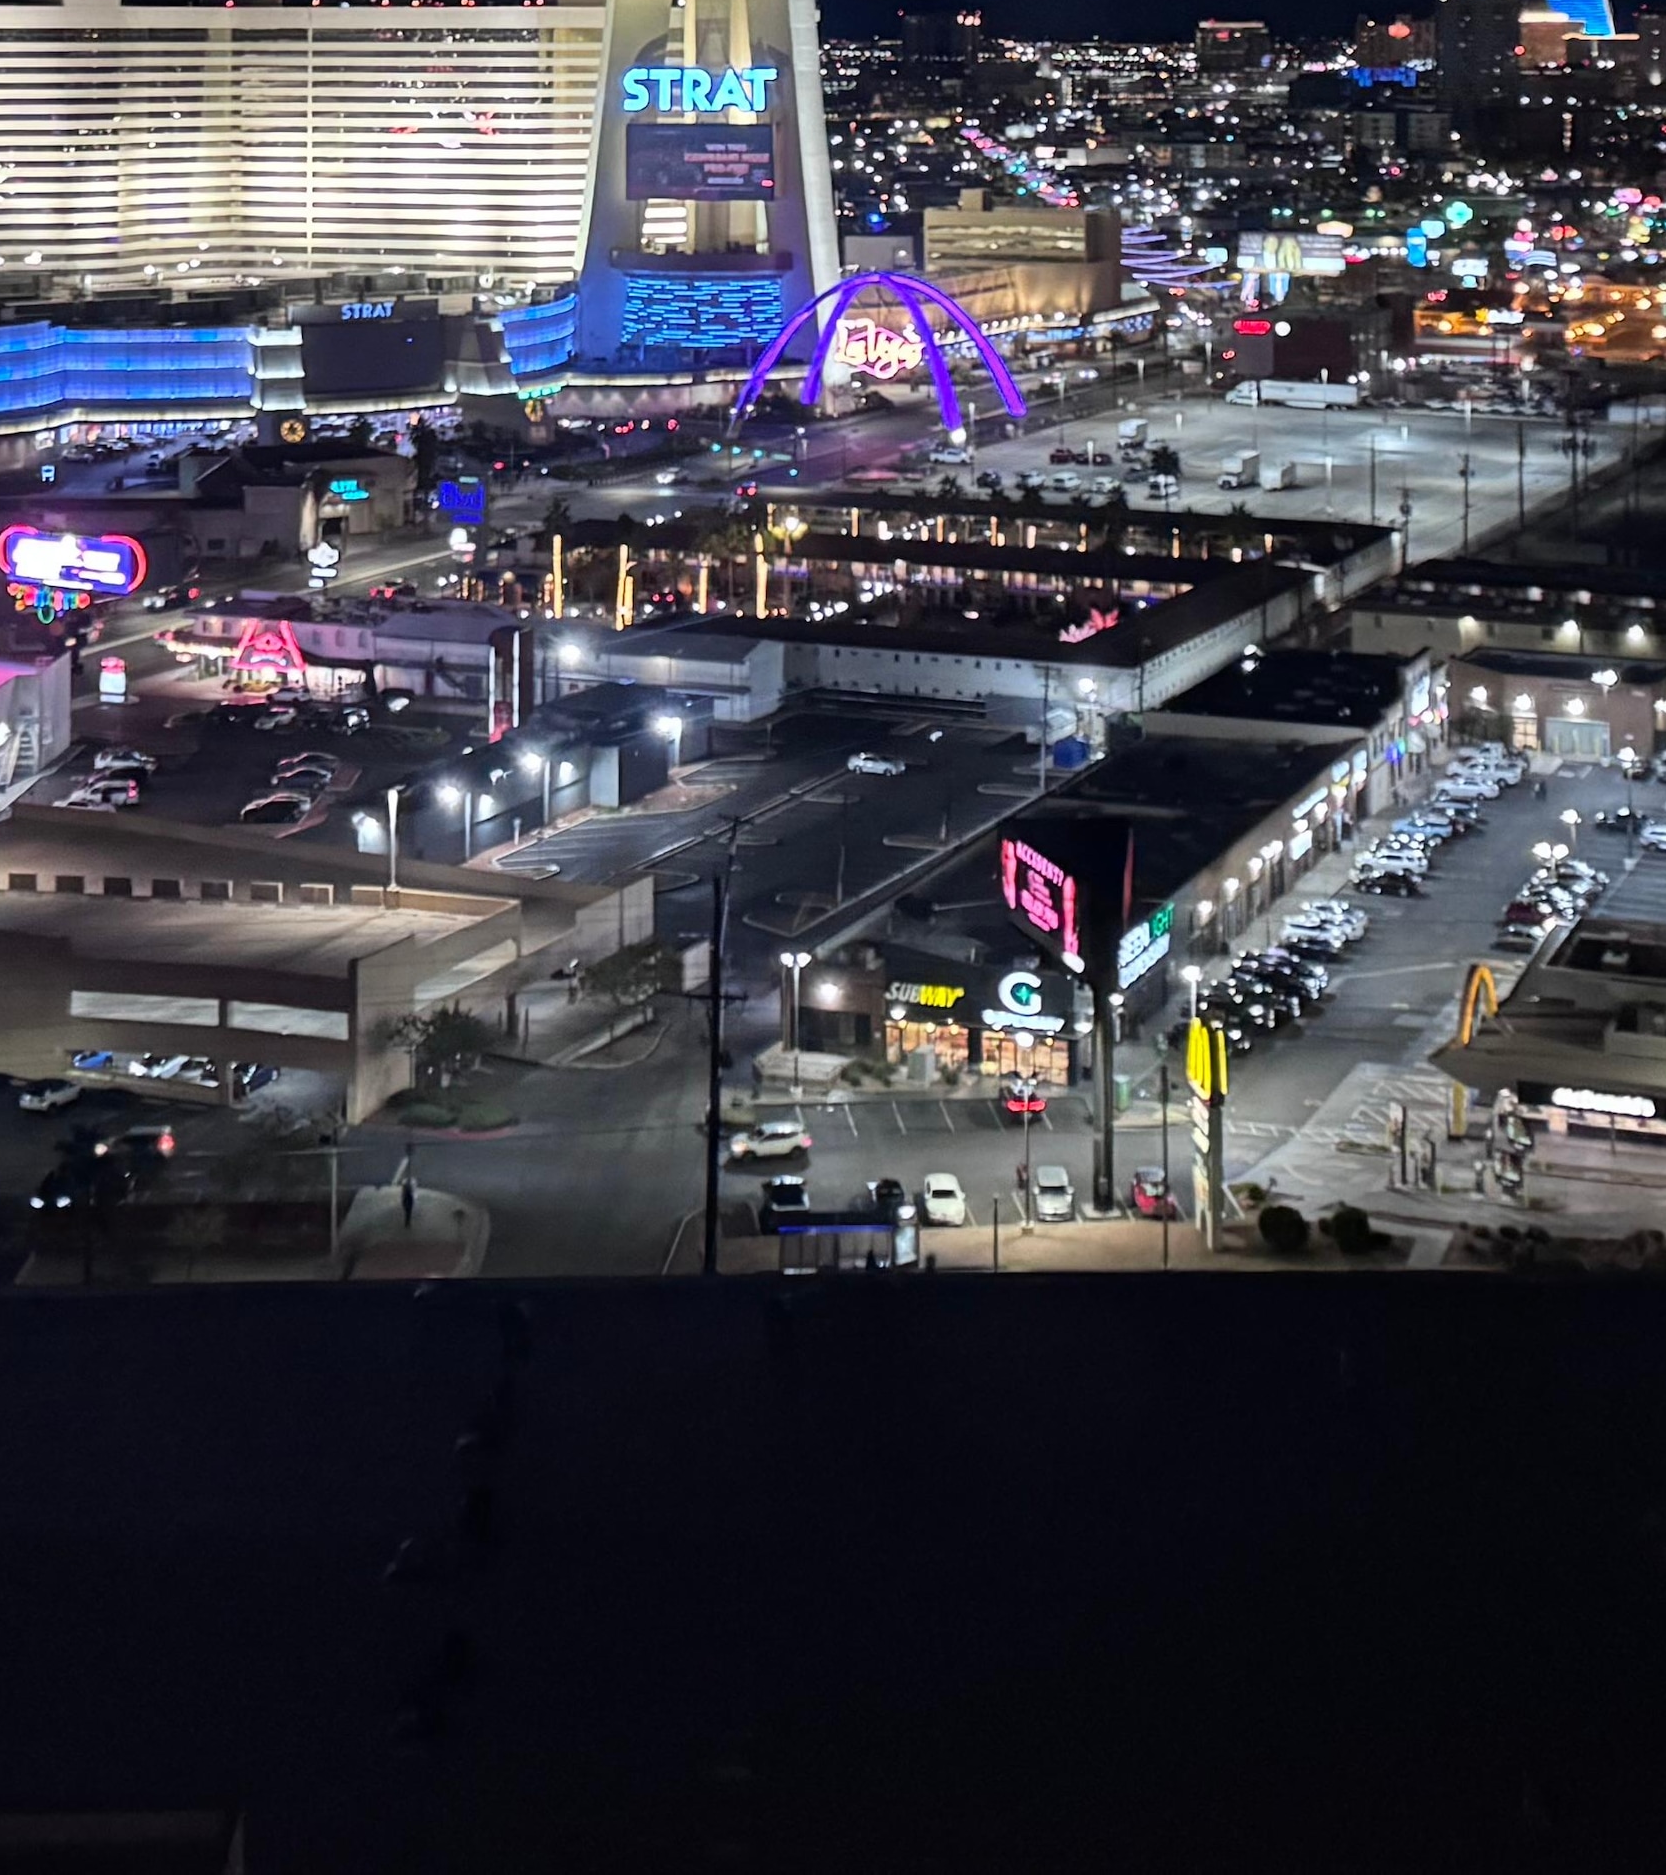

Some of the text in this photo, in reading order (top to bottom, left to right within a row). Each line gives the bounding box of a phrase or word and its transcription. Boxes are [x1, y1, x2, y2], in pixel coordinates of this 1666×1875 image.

[622, 67, 778, 112] STRAT
[341, 301, 394, 320] STRAT
[885, 982, 965, 1009] SUBWAY
